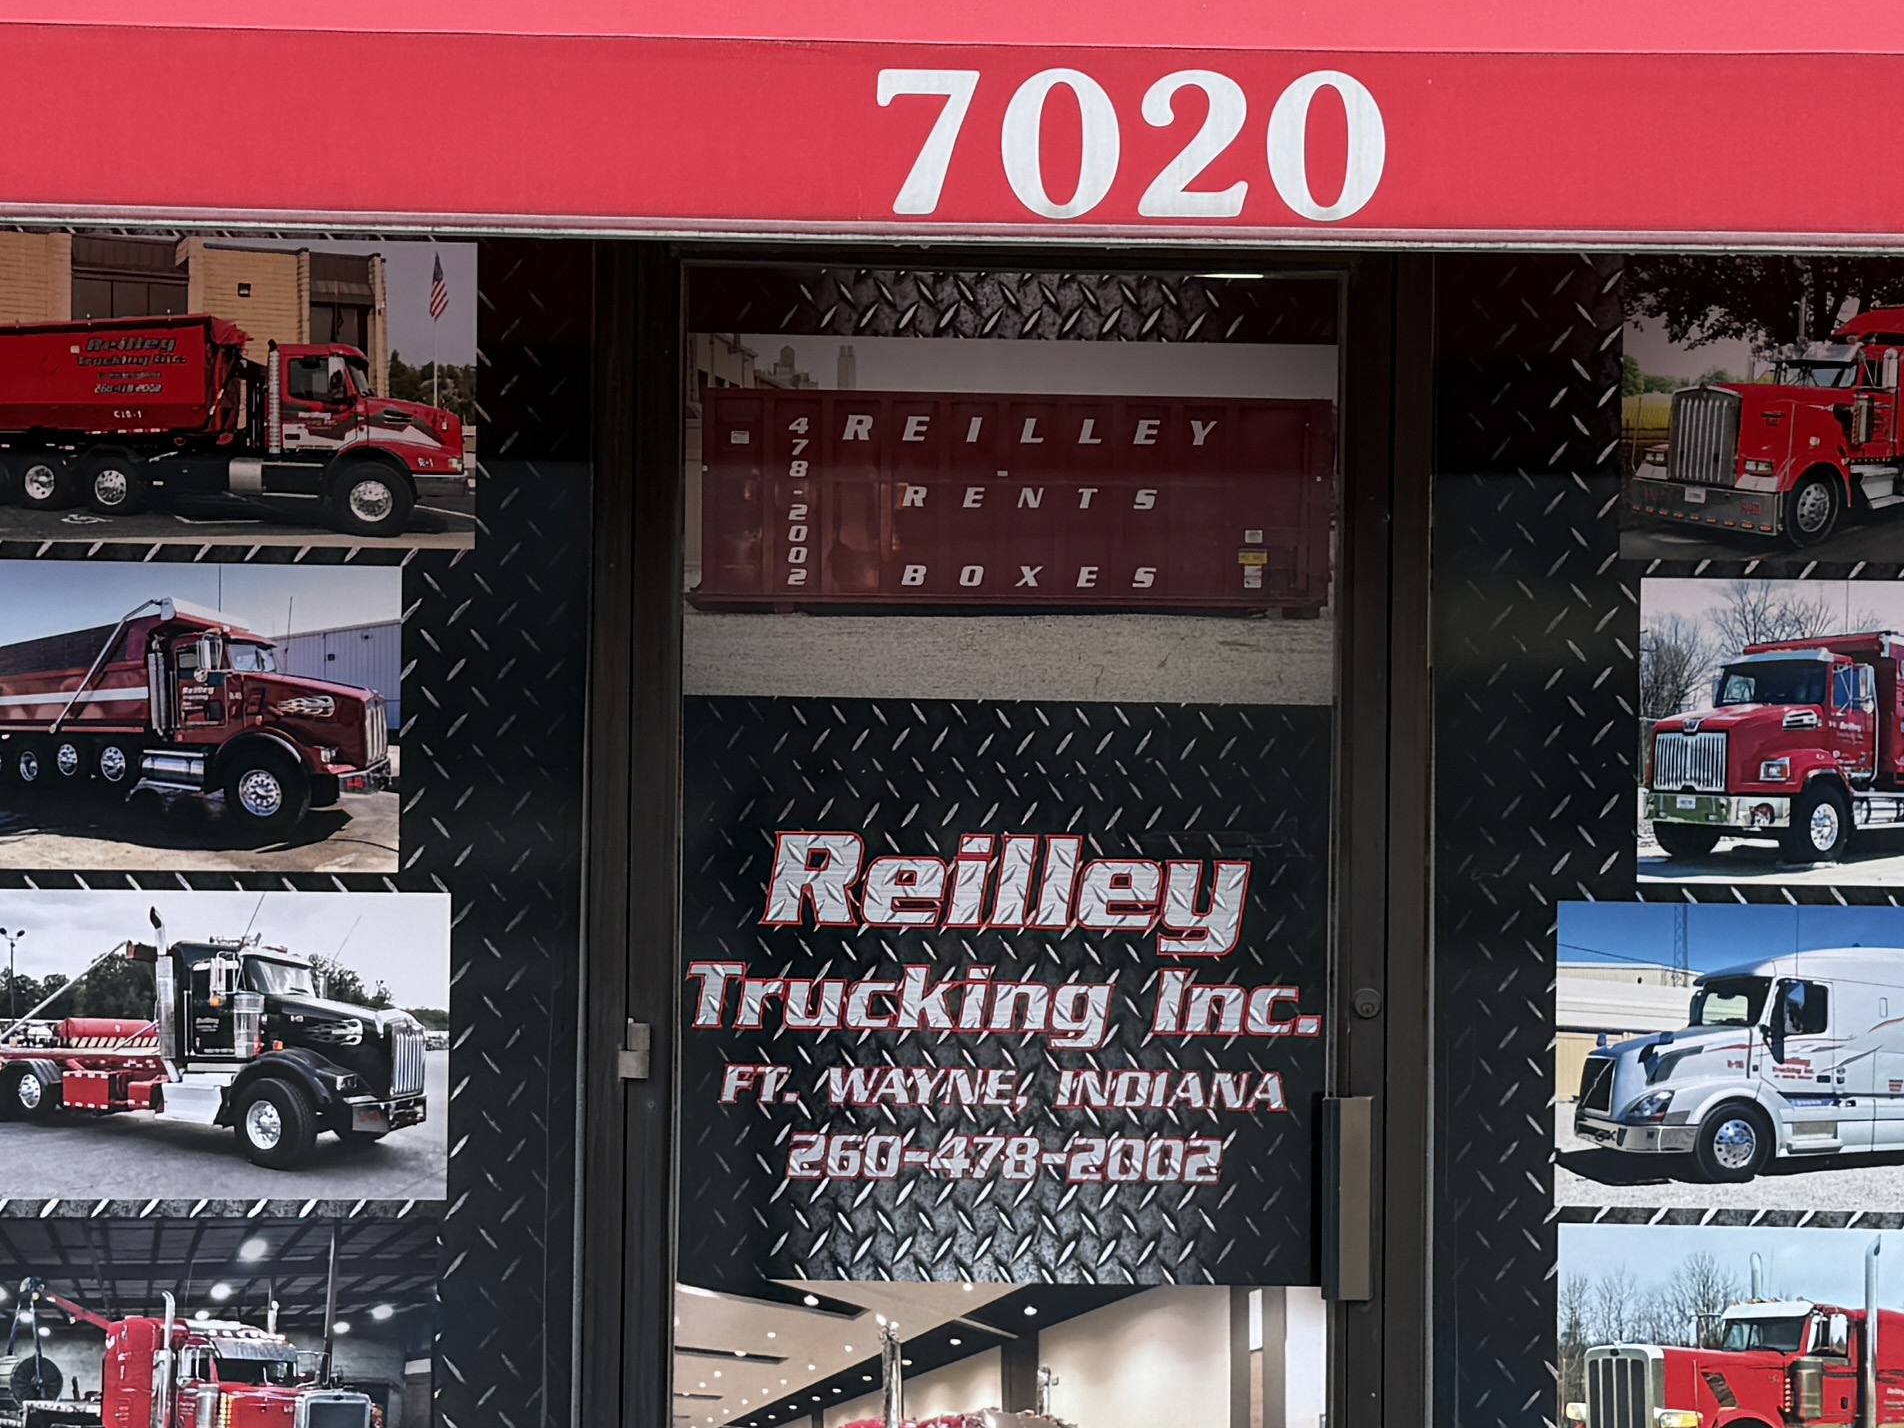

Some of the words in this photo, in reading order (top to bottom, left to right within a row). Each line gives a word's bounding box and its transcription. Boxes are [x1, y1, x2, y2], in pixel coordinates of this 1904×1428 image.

[876, 68, 1386, 222] 7020
[841, 414, 1218, 446] REILLEY
[787, 417, 810, 586] 478-2002
[901, 485, 1159, 510] RENTS
[901, 564, 1157, 588] BOXES
[758, 831, 1251, 956] Reilley
[686, 961, 1115, 1051] Trucking
[1150, 968, 1322, 1037] Inc.
[717, 1063, 800, 1105] FT.
[826, 1066, 1029, 1114] WAYNE,
[1052, 1068, 1288, 1113] INDIANA
[785, 1130, 1224, 1186] 260-478-2002
